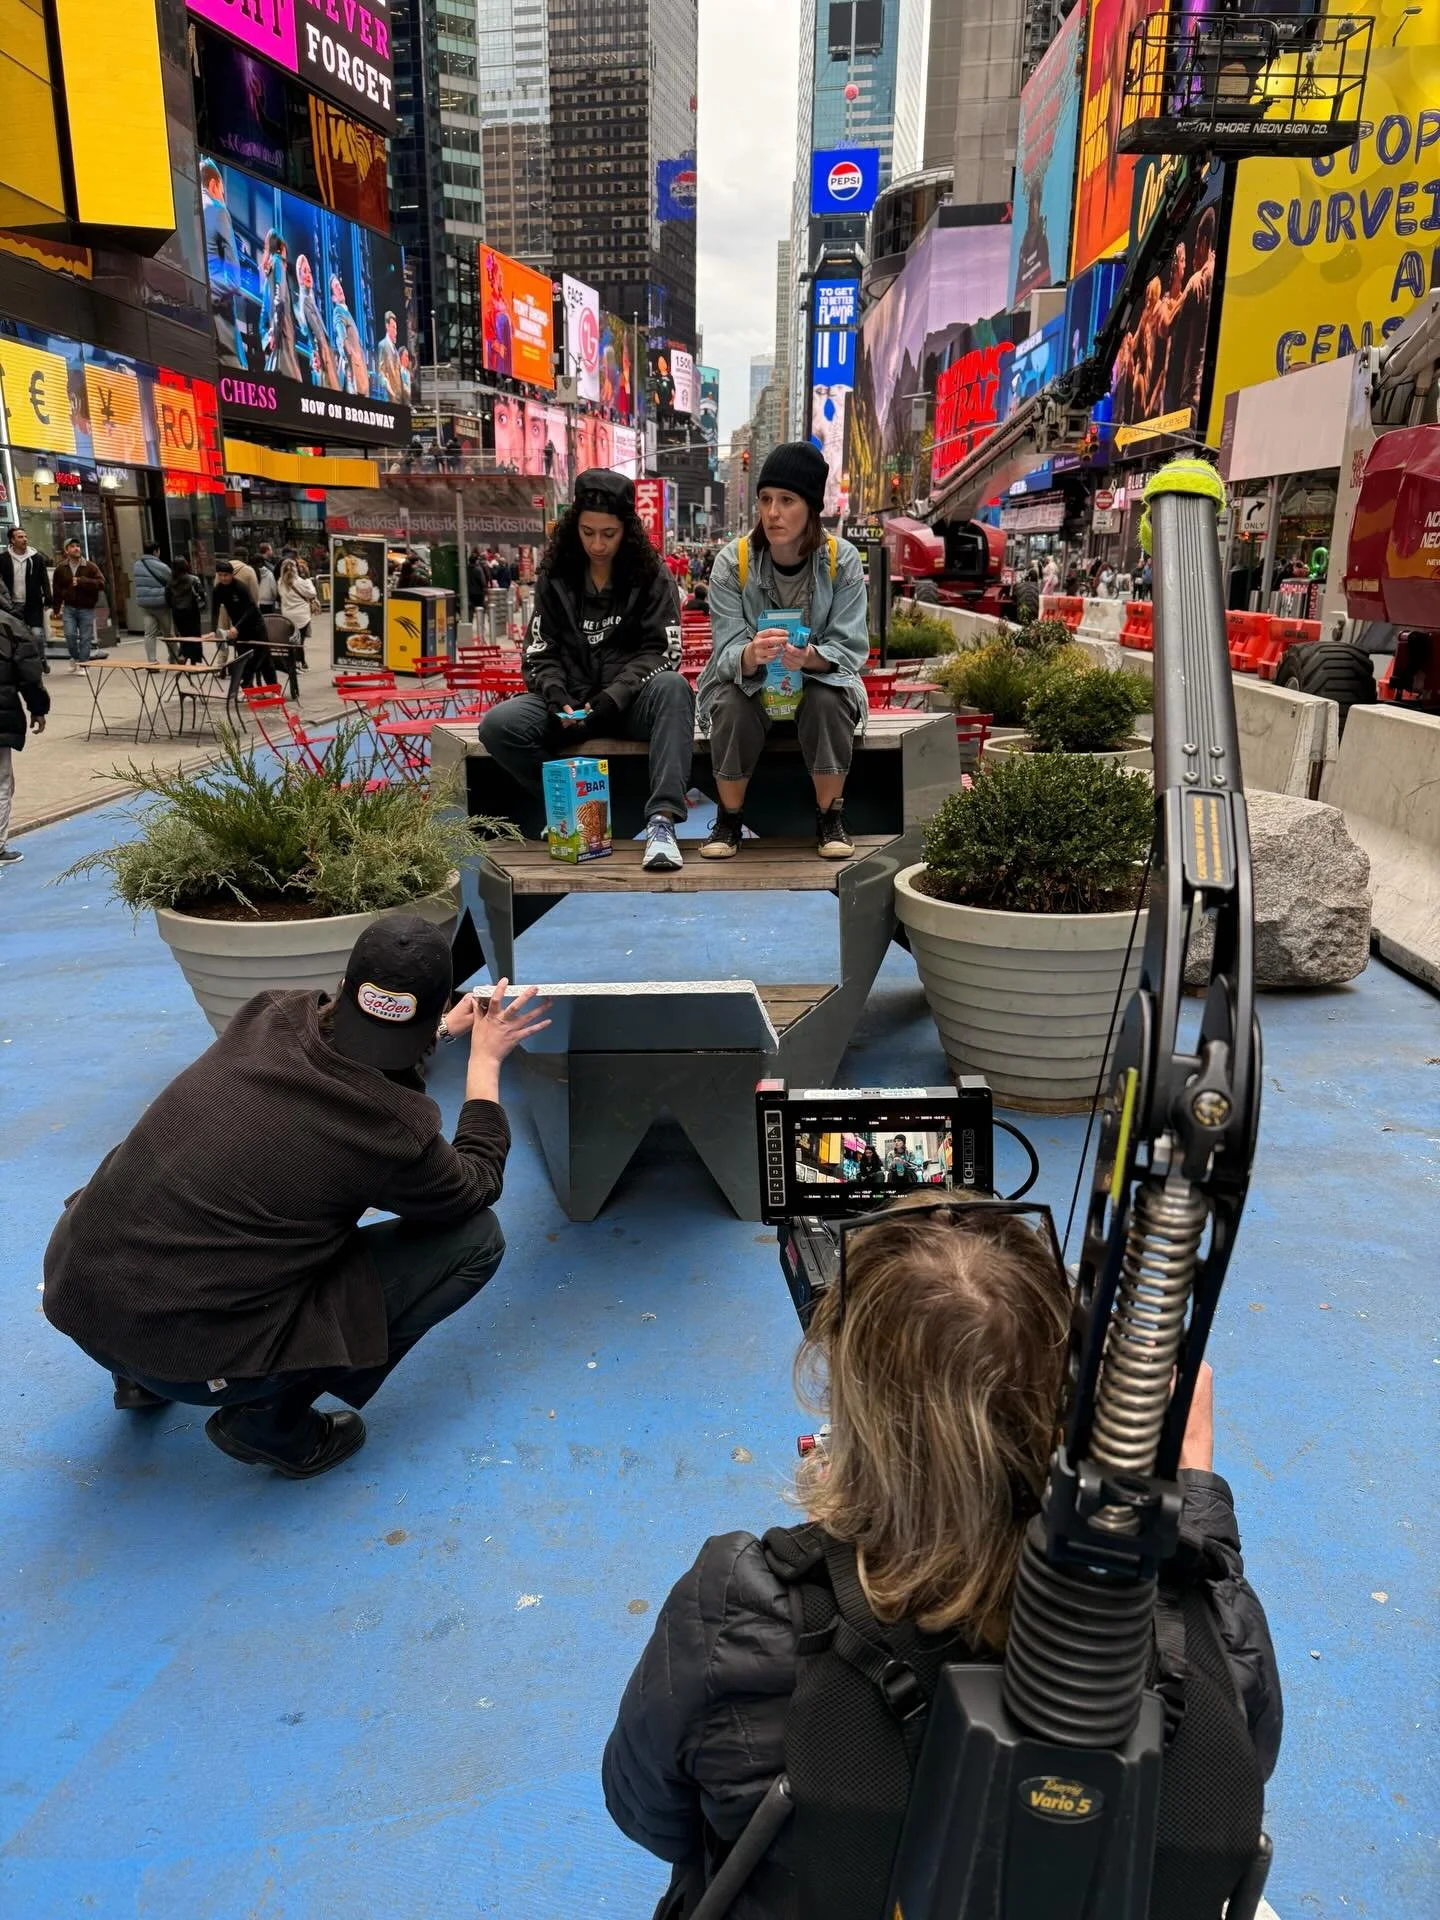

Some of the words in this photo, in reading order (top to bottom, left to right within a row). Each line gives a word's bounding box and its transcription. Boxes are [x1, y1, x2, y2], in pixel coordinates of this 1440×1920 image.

[306, 22, 392, 111] FORGET
[1215, 122, 1250, 134] SHORE
[1253, 122, 1284, 134] NEON
[1285, 123, 1310, 134] SIGN
[1311, 123, 1328, 135] CO.
[831, 176, 860, 186] PEPSI
[819, 287, 834, 296] TO
[834, 287, 855, 296] GET
[220, 378, 277, 410] CHESS
[301, 398, 325, 417] NOW
[328, 404, 342, 419] ON
[344, 407, 395, 429] BROADWAY
[637, 482, 659, 530] tkts
[1244, 522, 1265, 530] ONLY
[363, 991, 411, 1013] Golden
[1030, 1790, 1075, 1811] Vario
[1076, 1798, 1092, 1815] 5
